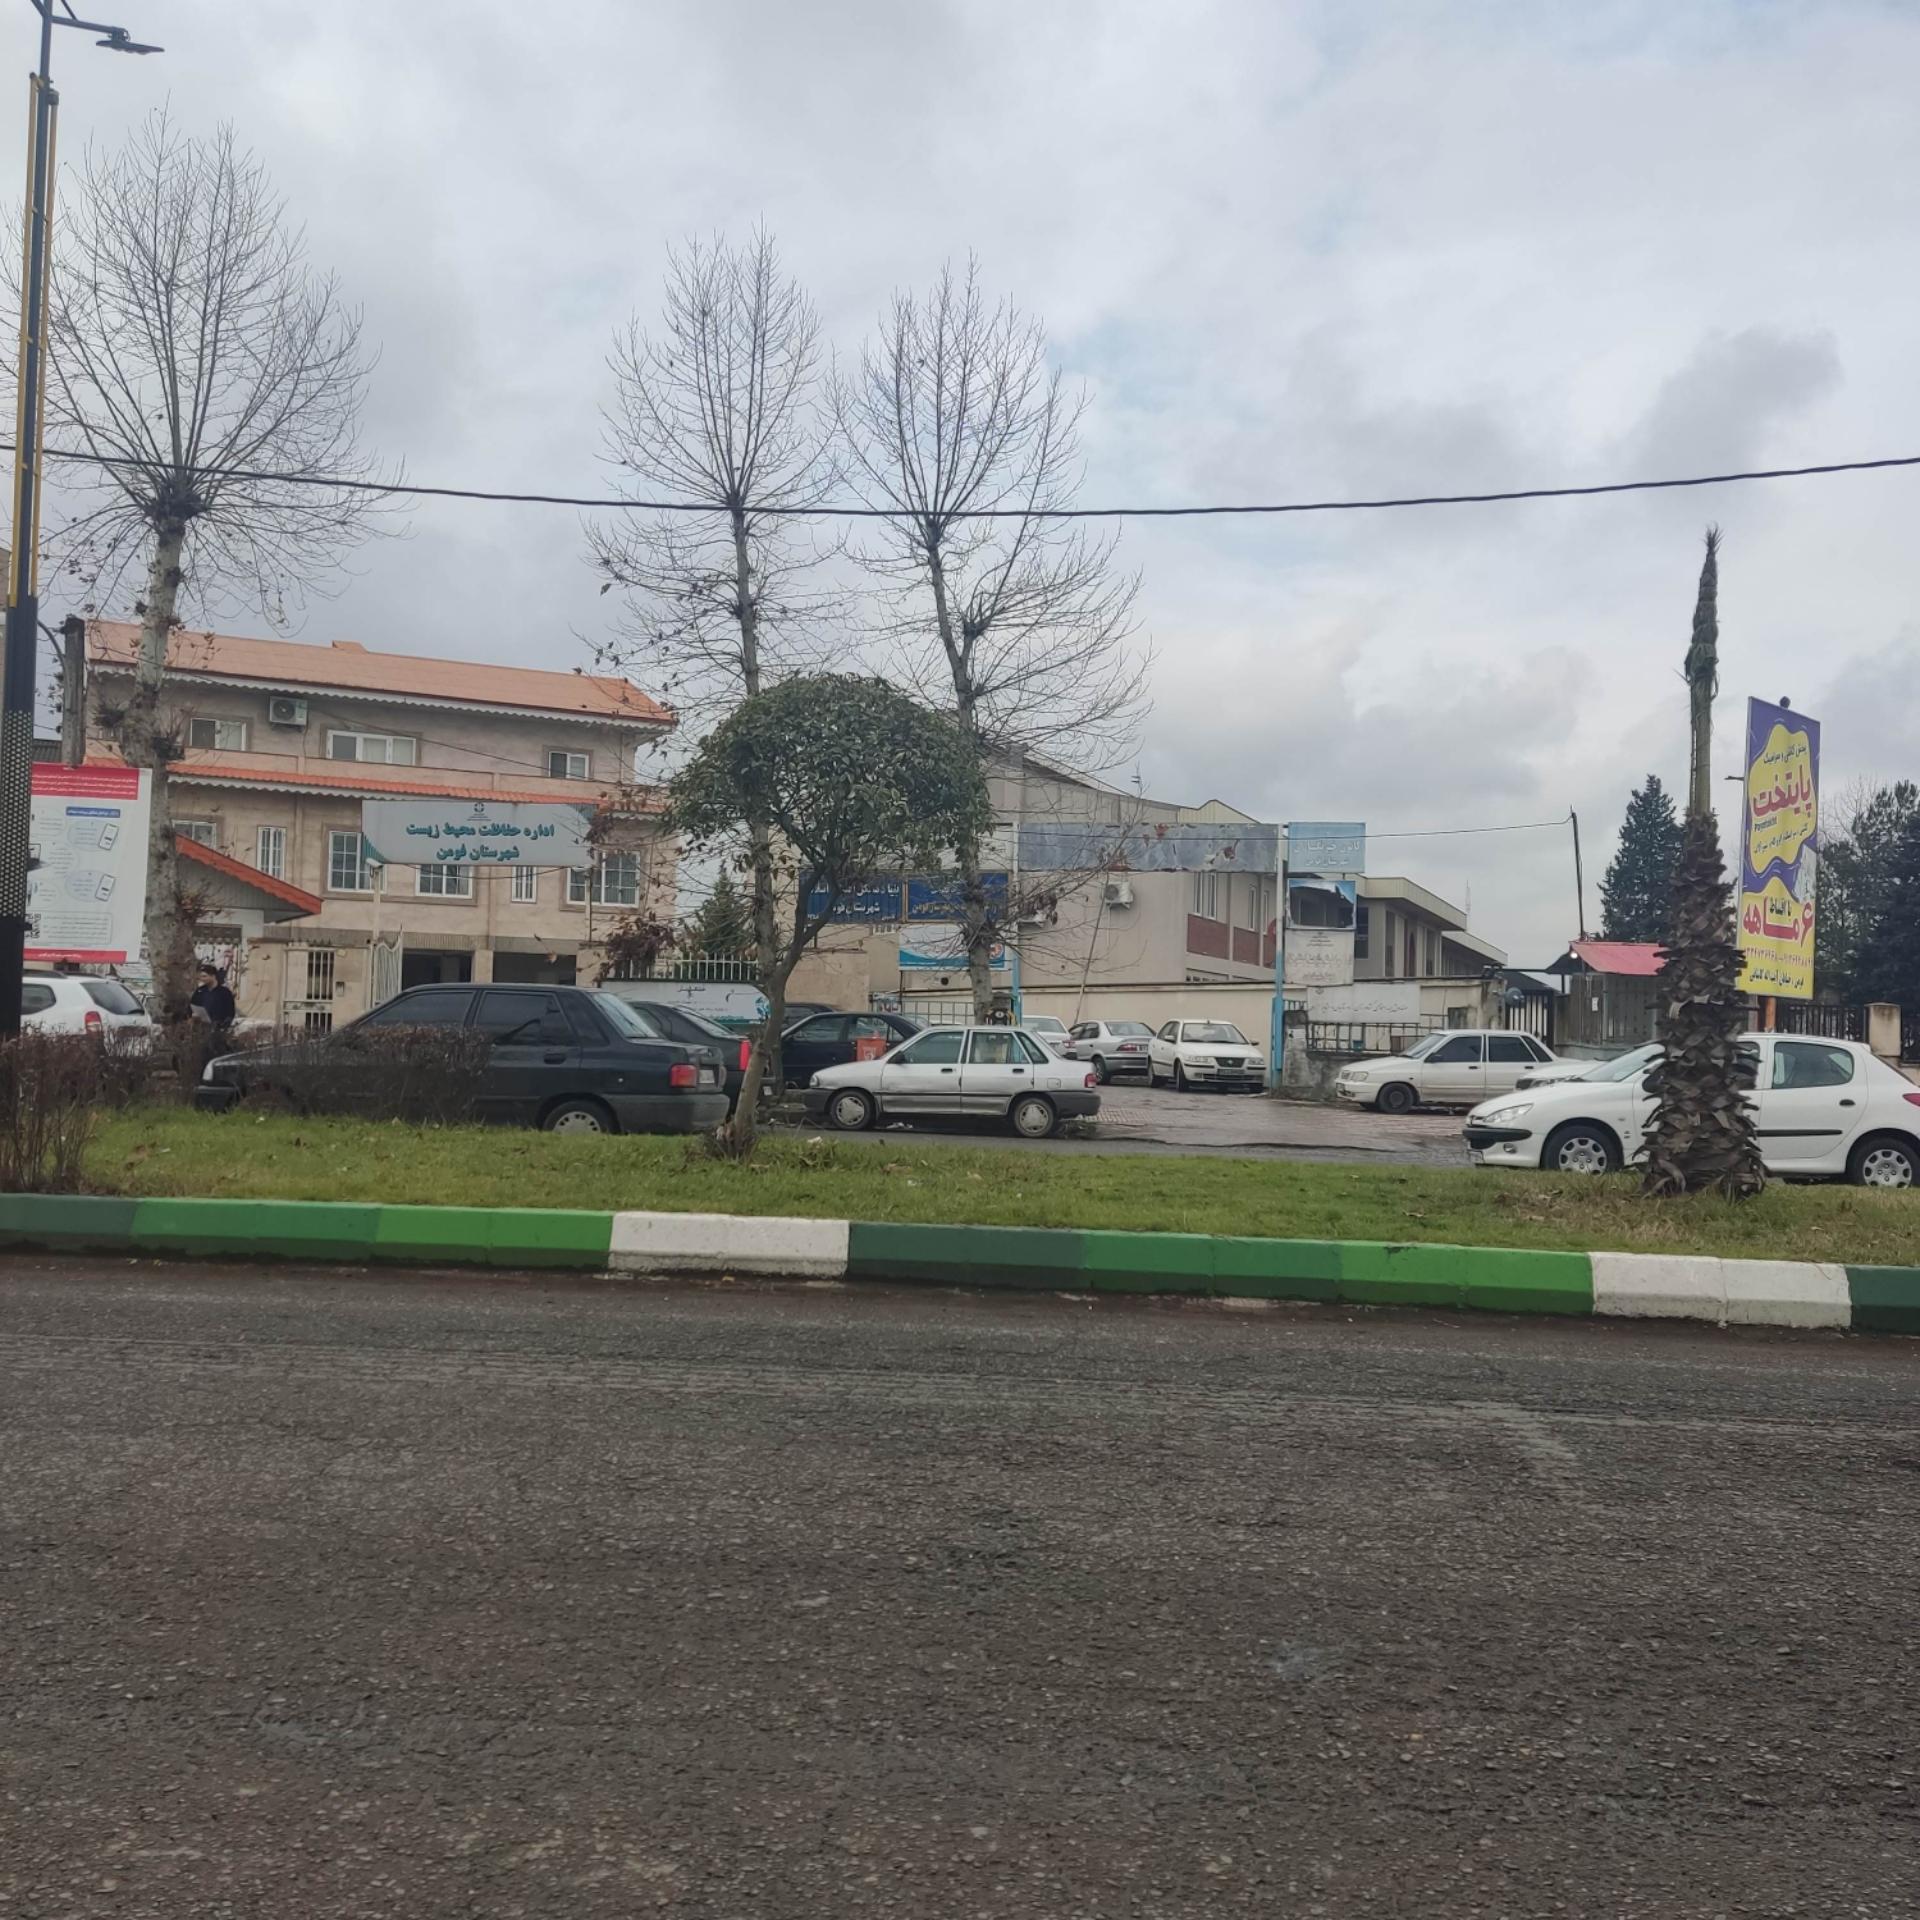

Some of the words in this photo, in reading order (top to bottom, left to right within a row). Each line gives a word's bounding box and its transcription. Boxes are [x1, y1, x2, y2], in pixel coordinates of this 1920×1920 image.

[1753, 764, 1812, 818] پایتخت
[406, 822, 440, 839] زیست
[442, 821, 476, 838] محیط
[478, 822, 521, 837] حفاظت
[523, 823, 555, 840] اداره
[436, 843, 467, 861] فومن
[469, 844, 520, 861] شهرستان
[1743, 895, 1800, 941] ماهه
[1801, 902, 1814, 948] ۶
